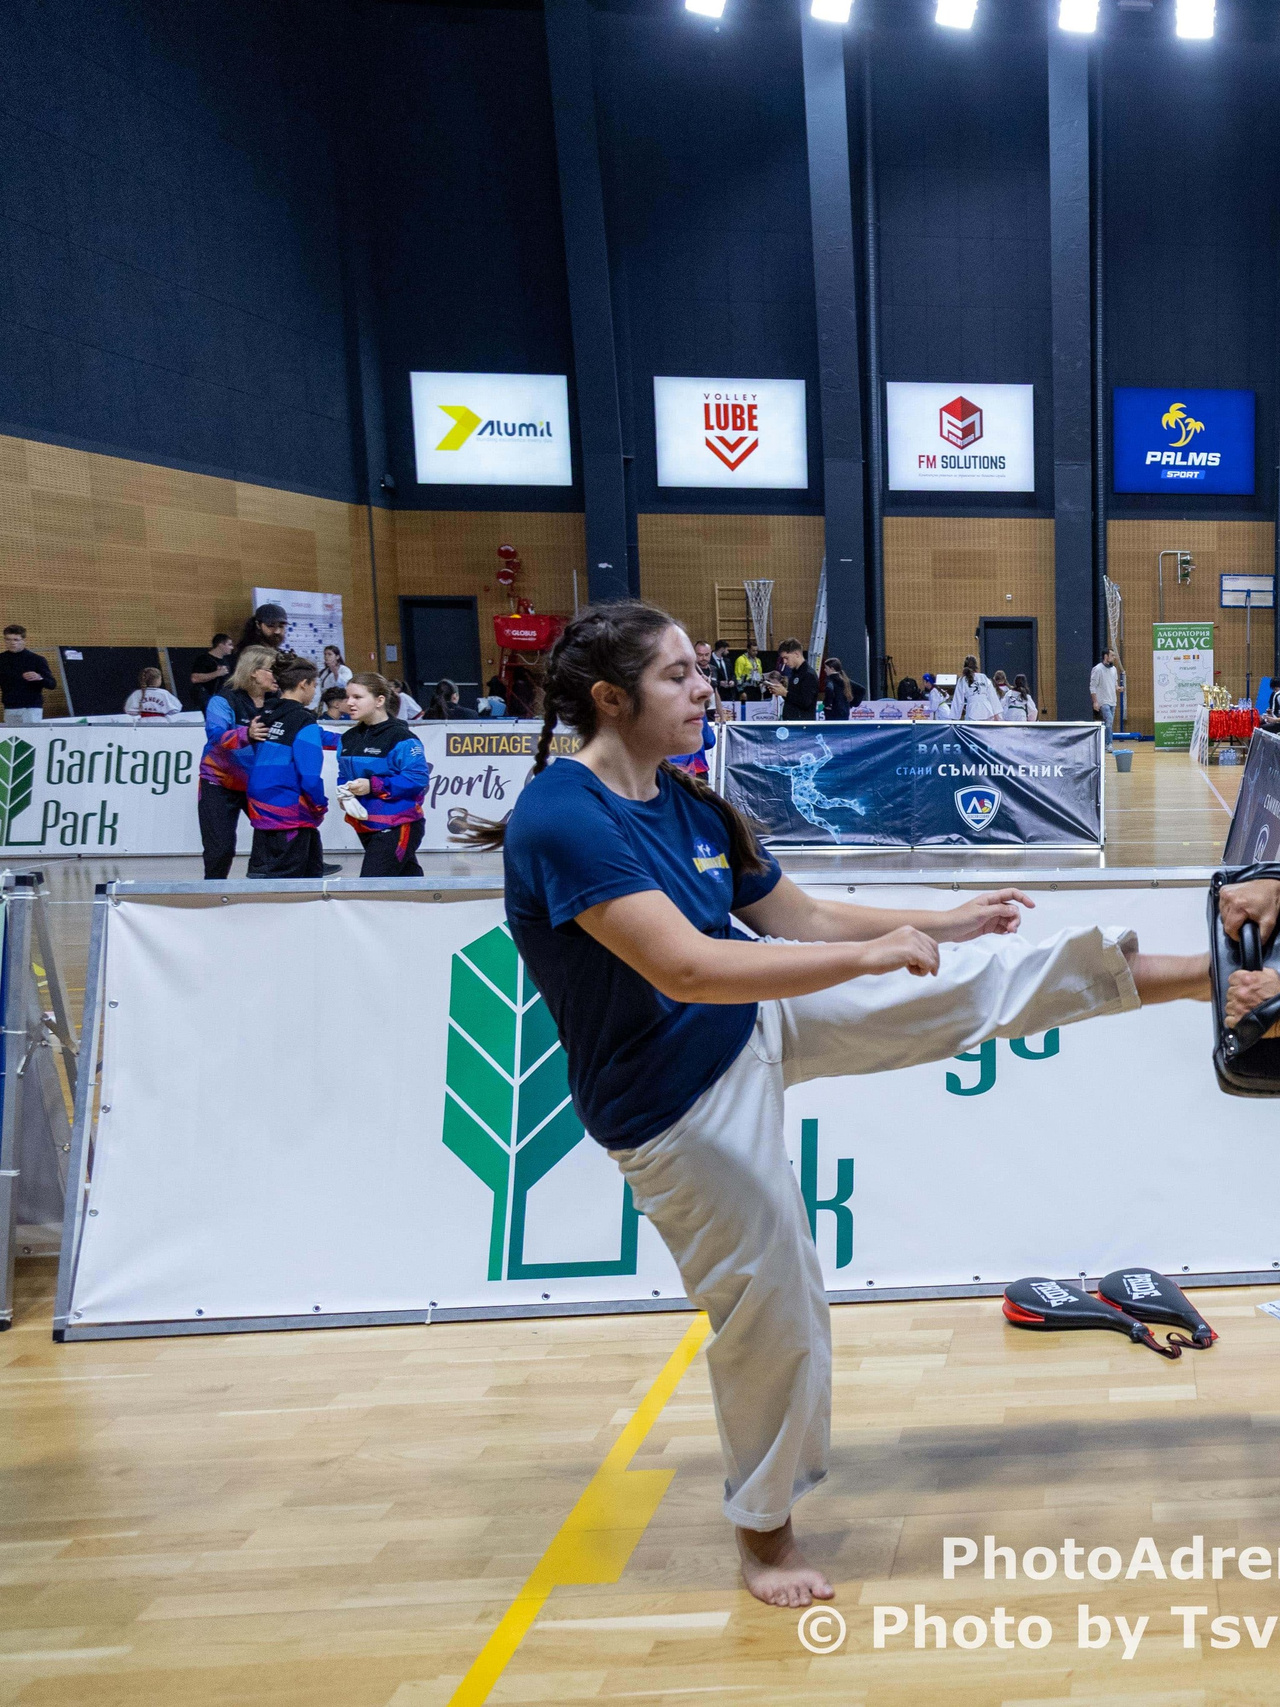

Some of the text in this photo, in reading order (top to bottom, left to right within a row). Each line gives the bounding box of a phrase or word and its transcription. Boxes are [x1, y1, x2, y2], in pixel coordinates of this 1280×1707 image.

[703, 393, 757, 401] VOLLEY
[704, 403, 758, 431] LUBE
[477, 420, 553, 437] Alumil
[918, 455, 1006, 470] FM SOLUTIONS
[1145, 451, 1221, 466] PALMS
[1166, 470, 1200, 478] SPORT
[511, 629, 537, 637] GLOBUS
[1157, 637, 1210, 649] РАМУС
[450, 736, 581, 754] GARITAGE ARK
[918, 743, 962, 755] ВЛЕЗ
[46, 738, 193, 795] Garitage
[896, 763, 1064, 778] СТАНИ СЪМИШЛЕНИК
[43, 800, 119, 846] Park
[1122, 1273, 1163, 1300] PRIDE
[1029, 1281, 1080, 1308] PRIDE
